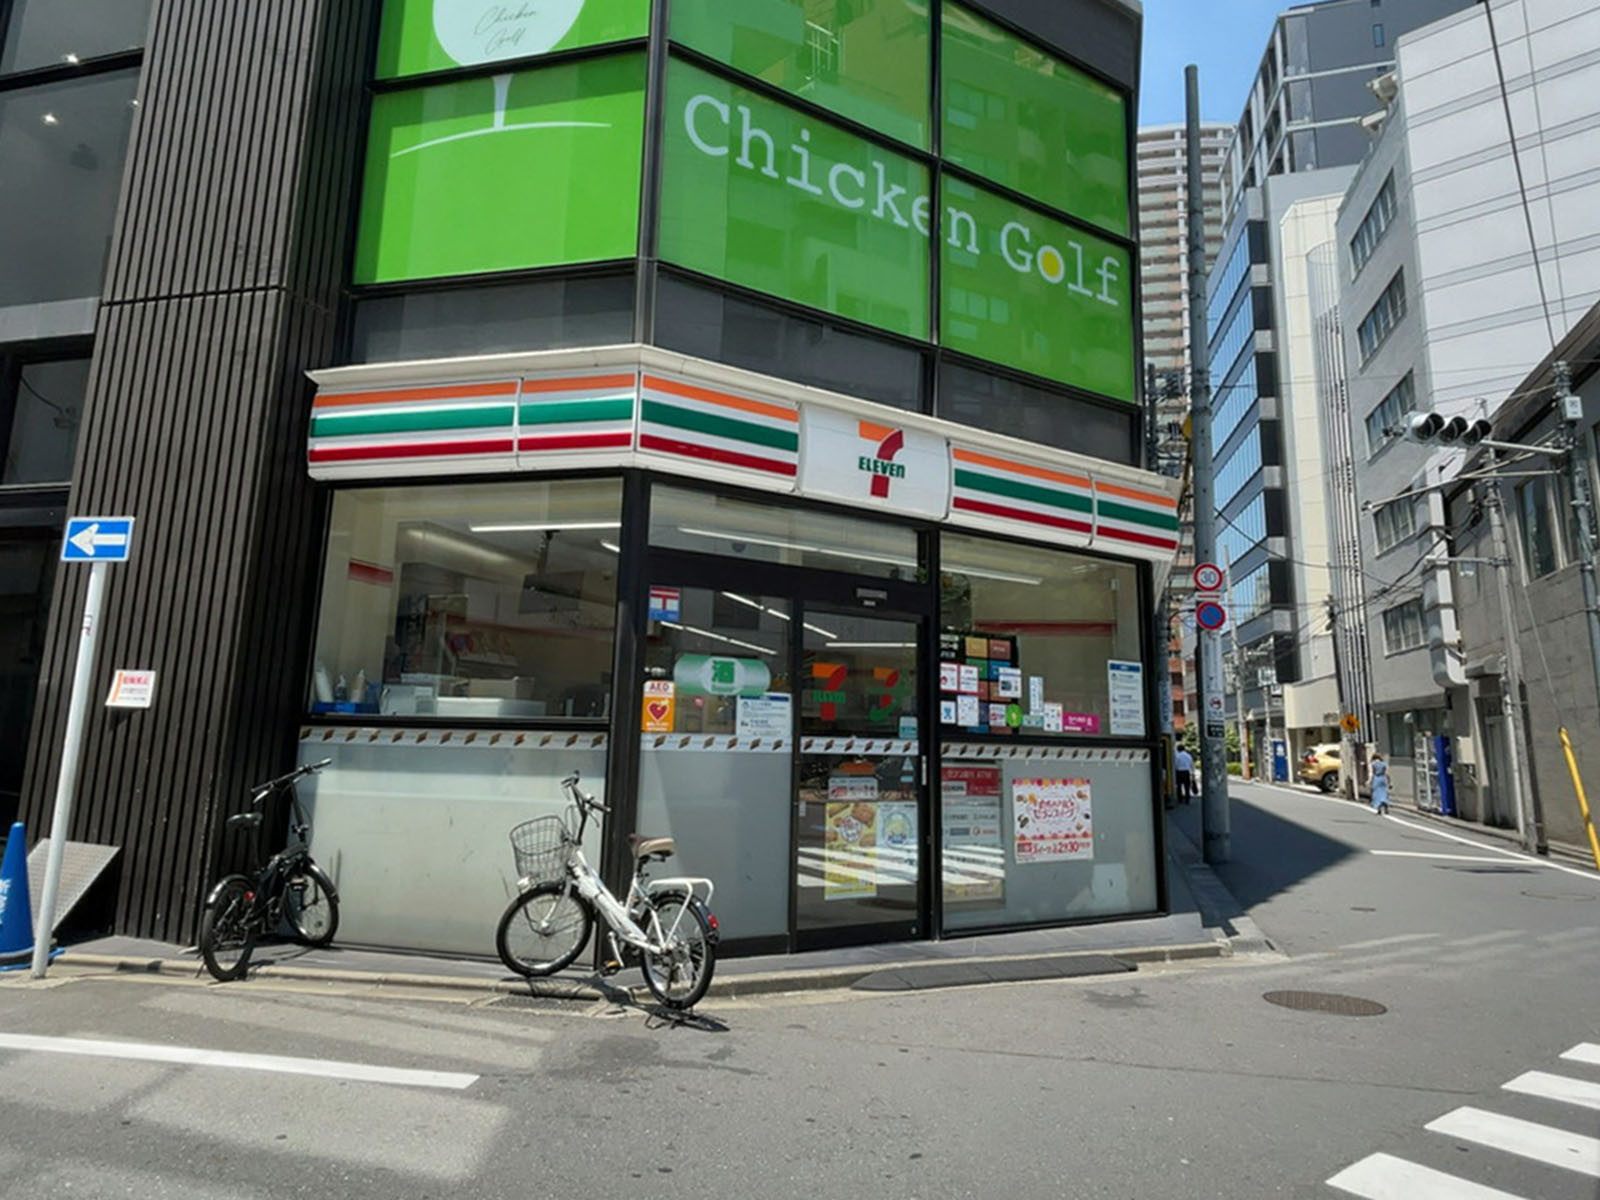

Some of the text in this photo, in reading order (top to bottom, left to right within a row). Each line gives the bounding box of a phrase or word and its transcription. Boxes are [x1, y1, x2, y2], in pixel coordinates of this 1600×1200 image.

[684, 94, 1120, 306] Chicken Golf
[858, 420, 904, 499] 7
[1201, 569, 1218, 585] 30
[649, 682, 670, 692] AED
